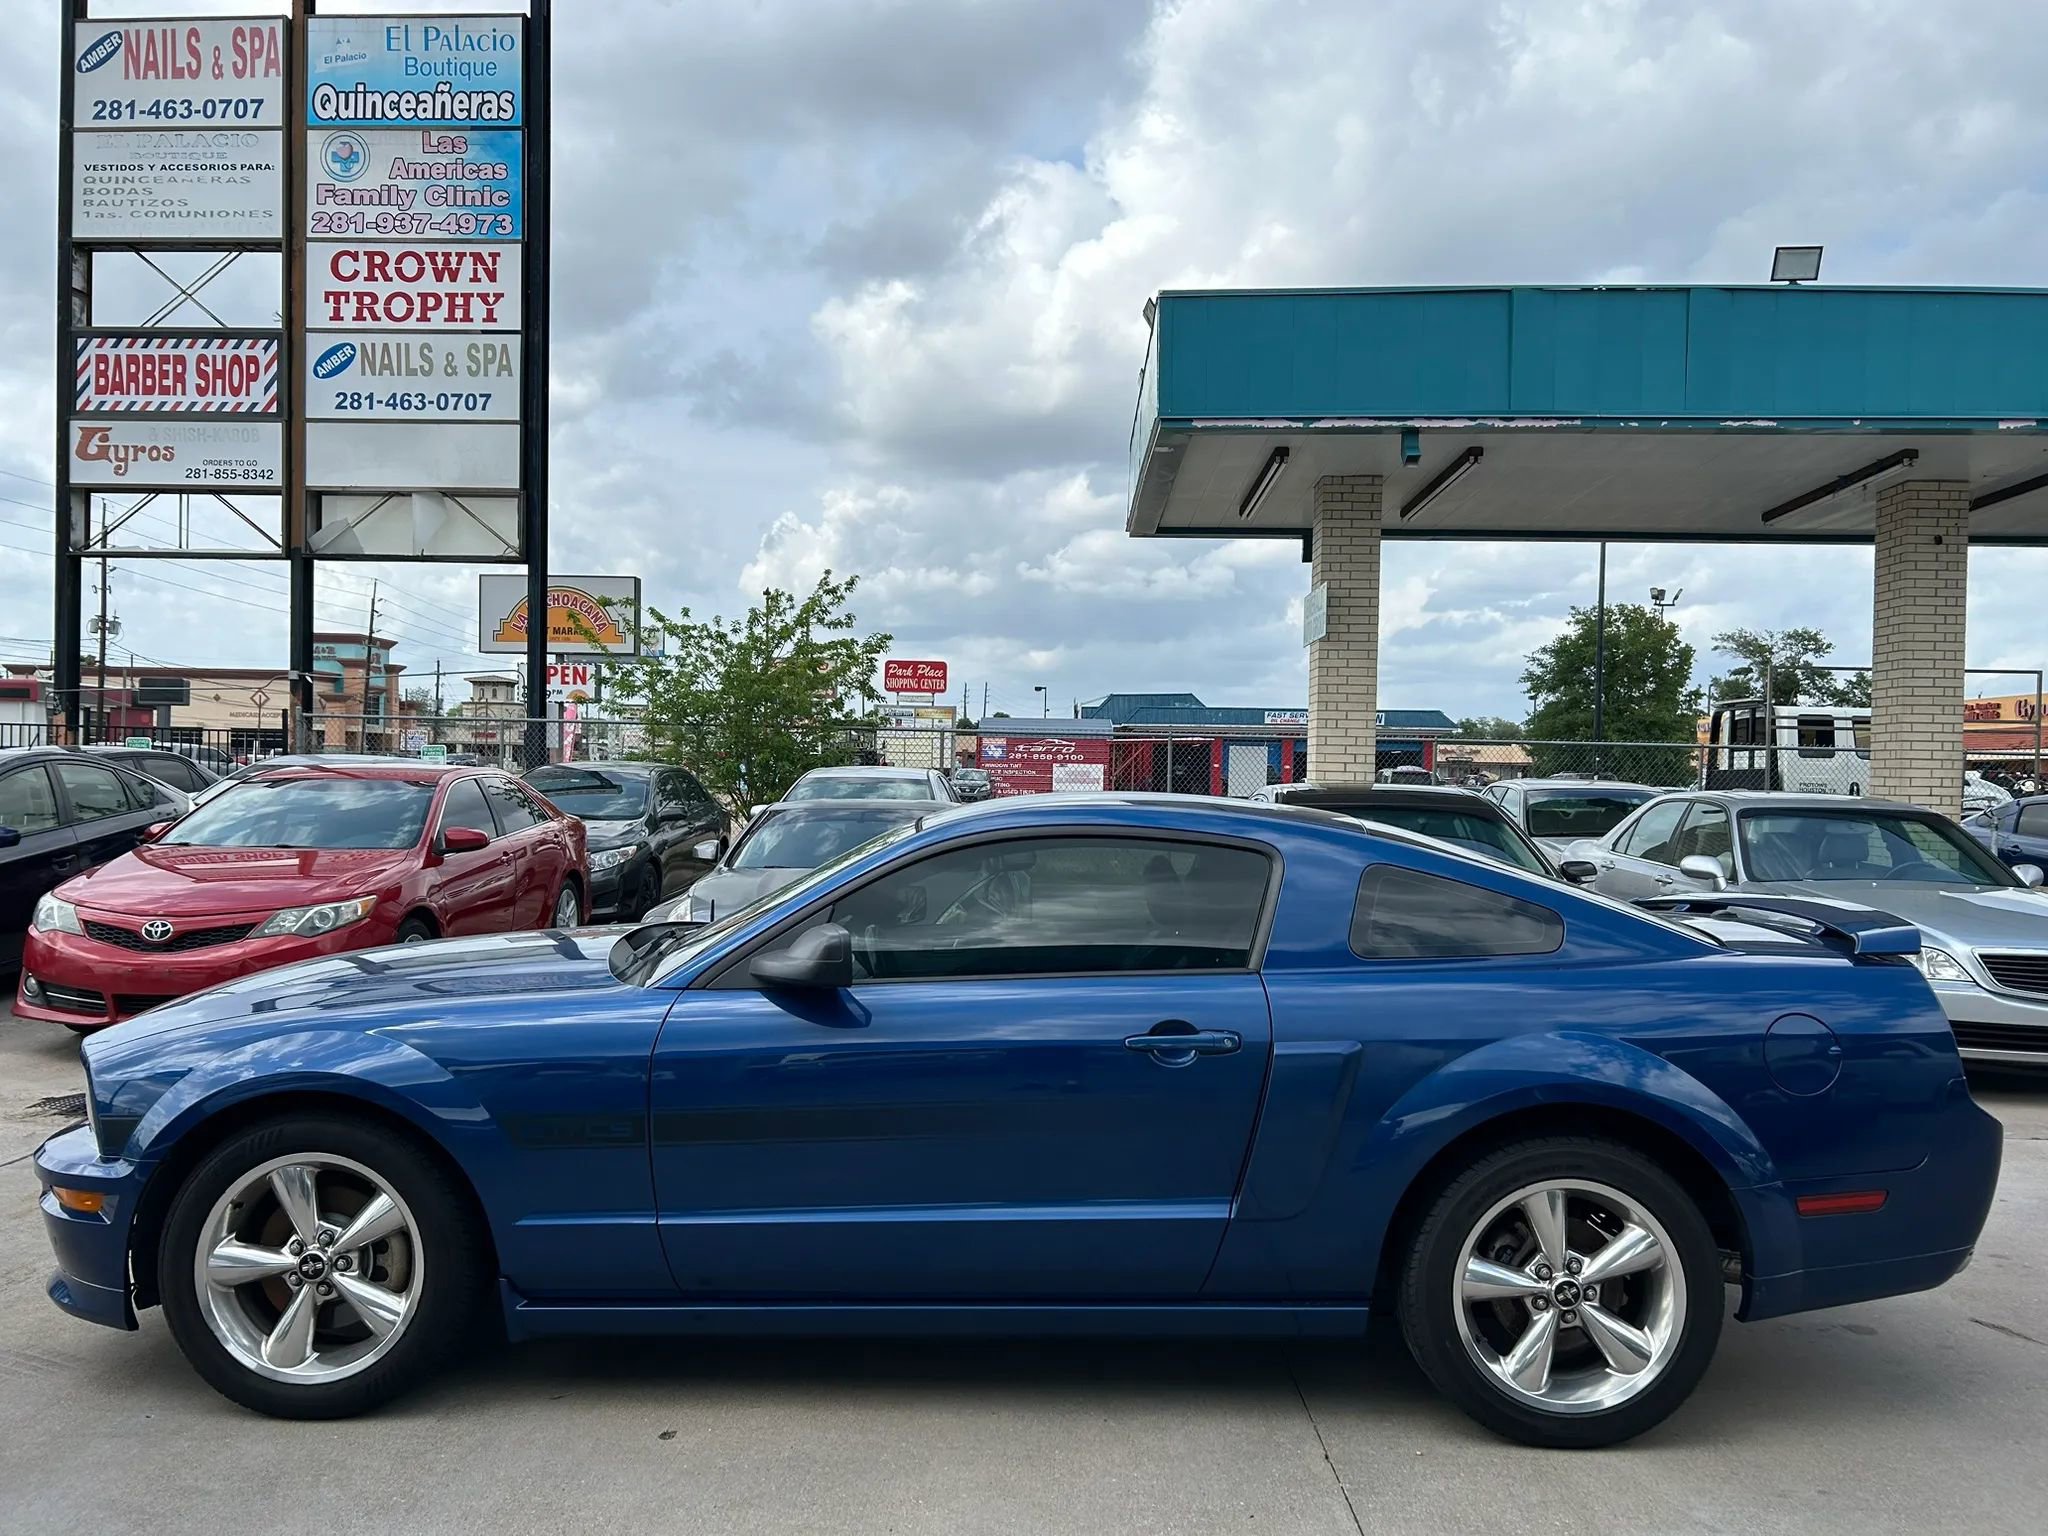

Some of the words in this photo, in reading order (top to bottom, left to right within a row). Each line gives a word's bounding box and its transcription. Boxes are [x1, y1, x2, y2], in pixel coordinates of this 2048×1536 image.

[78, 33, 123, 73] AMBER
[123, 27, 202, 81] NAILS
[212, 45, 224, 81] &
[231, 26, 282, 80] SPA
[324, 56, 333, 65] El
[334, 52, 367, 63] Palacio
[404, 56, 498, 81] Boutique
[91, 98, 265, 120] 281-463-0707
[312, 81, 515, 121] Quinceañeras
[421, 131, 469, 154] Las
[83, 164, 145, 172] VESTIDOS
[159, 163, 238, 172] ACCESORIOS
[240, 163, 275, 171] PARA:
[388, 158, 508, 180] Americas
[82, 187, 153, 196] BODAS
[316, 184, 418, 211] Family
[424, 185, 511, 207] Clinic
[82, 199, 189, 208] BAUTIZOS
[82, 210, 123, 219] 1as.
[129, 210, 274, 219] COMUNIONES
[311, 212, 513, 235] 281-937-4973
[330, 249, 501, 283] CROWN
[324, 291, 505, 323] TROPHY
[315, 345, 355, 378] AMBER
[359, 342, 434, 377] NAILS
[443, 352, 459, 377] &
[466, 342, 514, 377] SPA
[94, 353, 187, 396] BARBER
[195, 353, 260, 397] SHOP
[334, 392, 492, 411] 281-463-0707
[75, 426, 175, 477] Gyros
[185, 468, 274, 480] 281-855-8342
[547, 666, 587, 685] PEN
[888, 663, 913, 677] Park
[917, 664, 944, 677] Place
[886, 678, 919, 689] SHOPPING
[920, 679, 945, 690] CENTER
